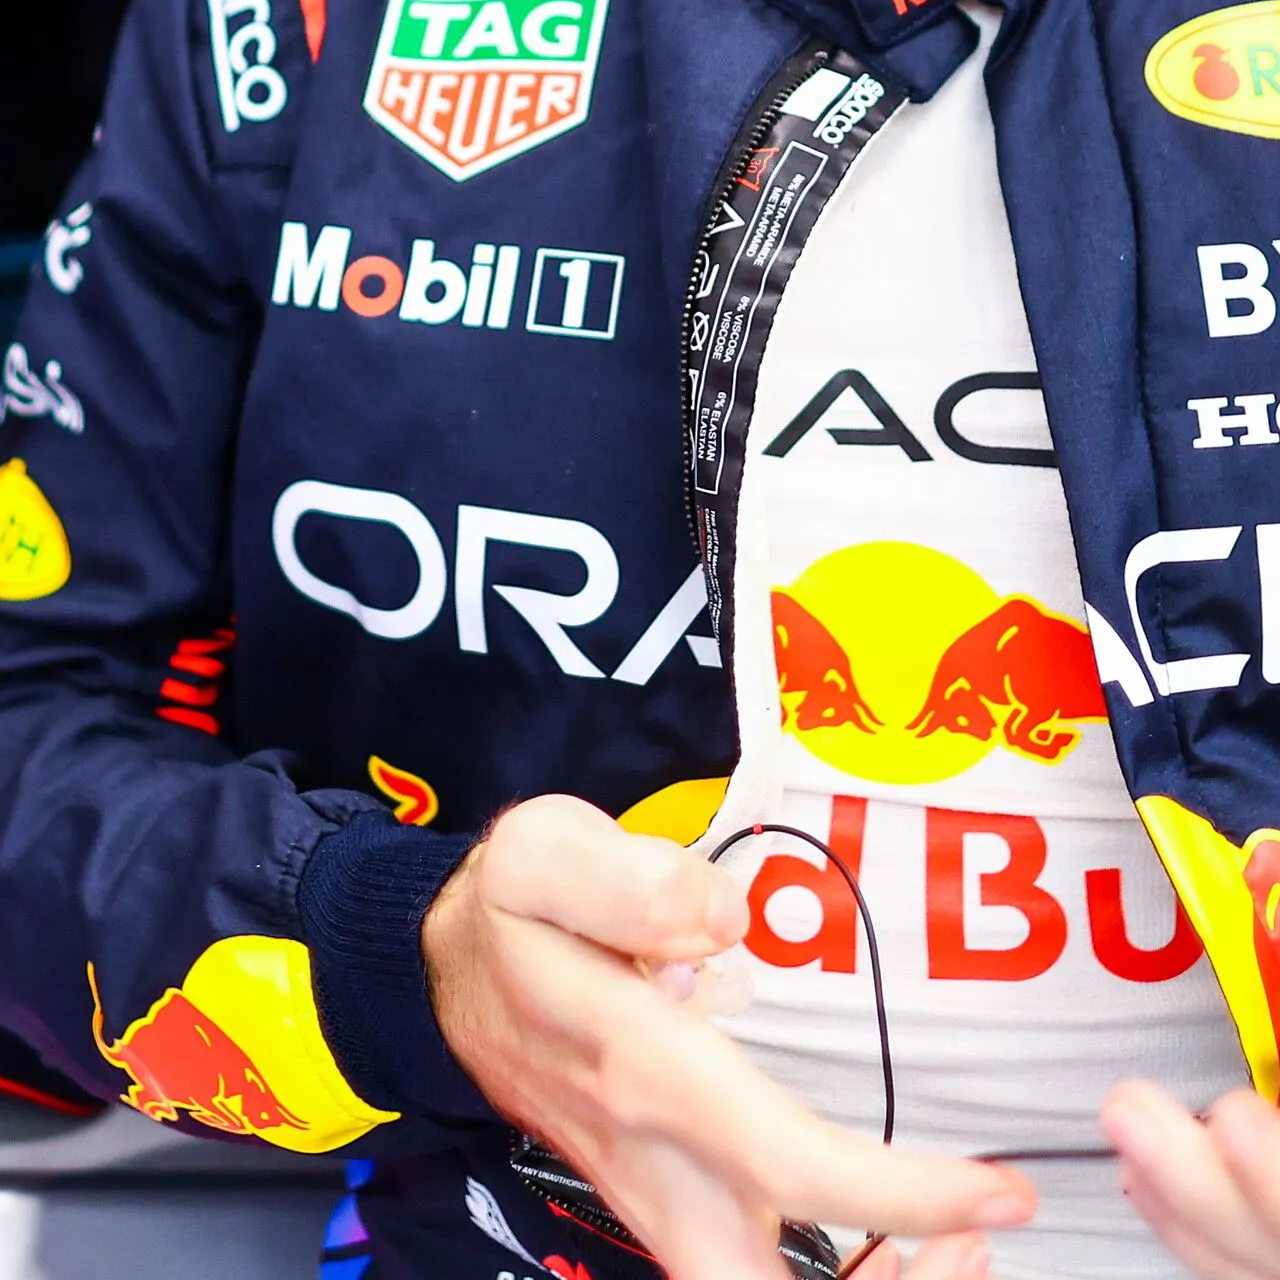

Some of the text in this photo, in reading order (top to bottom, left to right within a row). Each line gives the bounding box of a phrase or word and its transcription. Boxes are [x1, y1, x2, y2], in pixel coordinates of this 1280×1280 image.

[408, 0, 588, 59] TAG
[383, 70, 582, 159] HEUER
[813, 72, 885, 145] sparco
[745, 186, 784, 258] META-ARAMID
[753, 190, 796, 267] META-ARAMIDE
[271, 221, 520, 330] Mobil
[711, 311, 734, 361] VISCOSE
[722, 313, 745, 364] VISCOSA
[697, 407, 711, 460] ELASTAN
[705, 391, 728, 462] 6% ELASTAN
